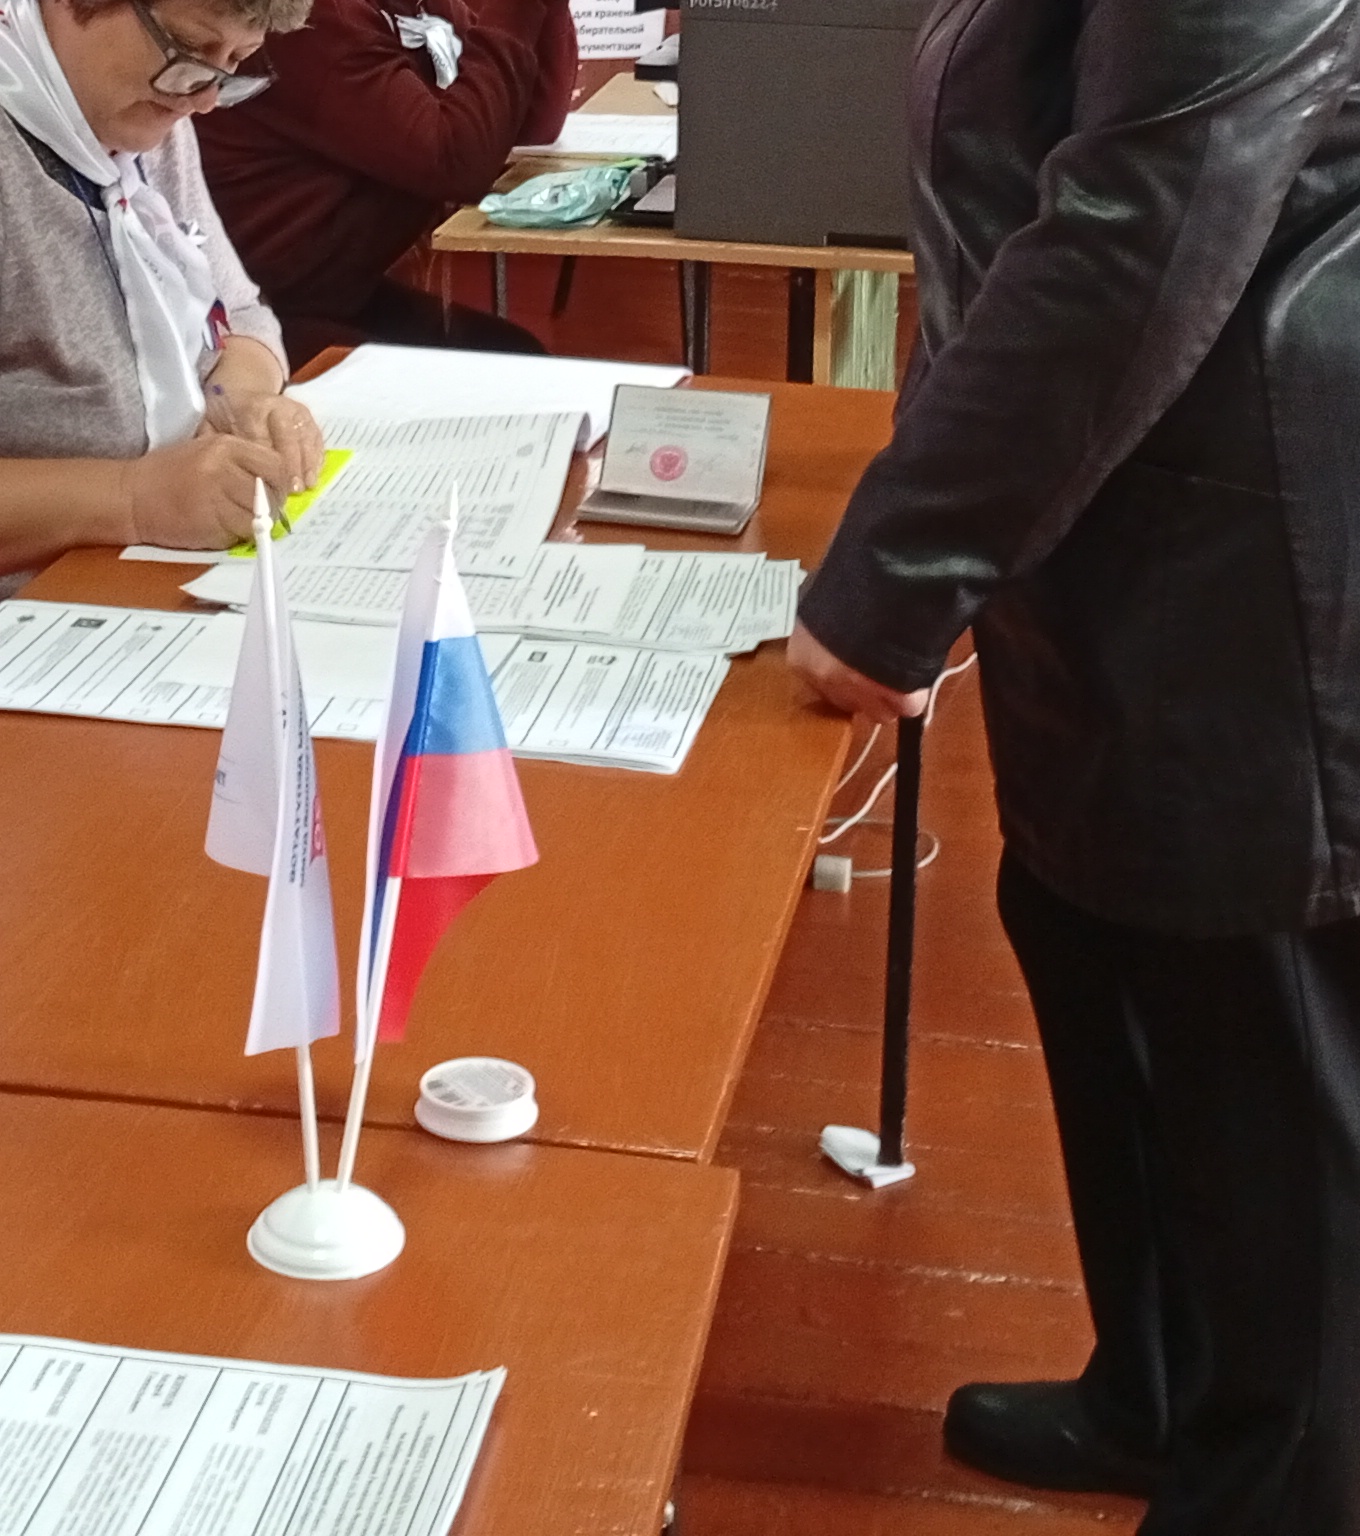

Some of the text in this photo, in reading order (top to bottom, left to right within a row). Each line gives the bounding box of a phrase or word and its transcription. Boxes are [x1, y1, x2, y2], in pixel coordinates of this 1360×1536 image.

[574, 10, 635, 20] для хранени
[576, 24, 644, 36] бирательной
[578, 44, 641, 54] кументации
